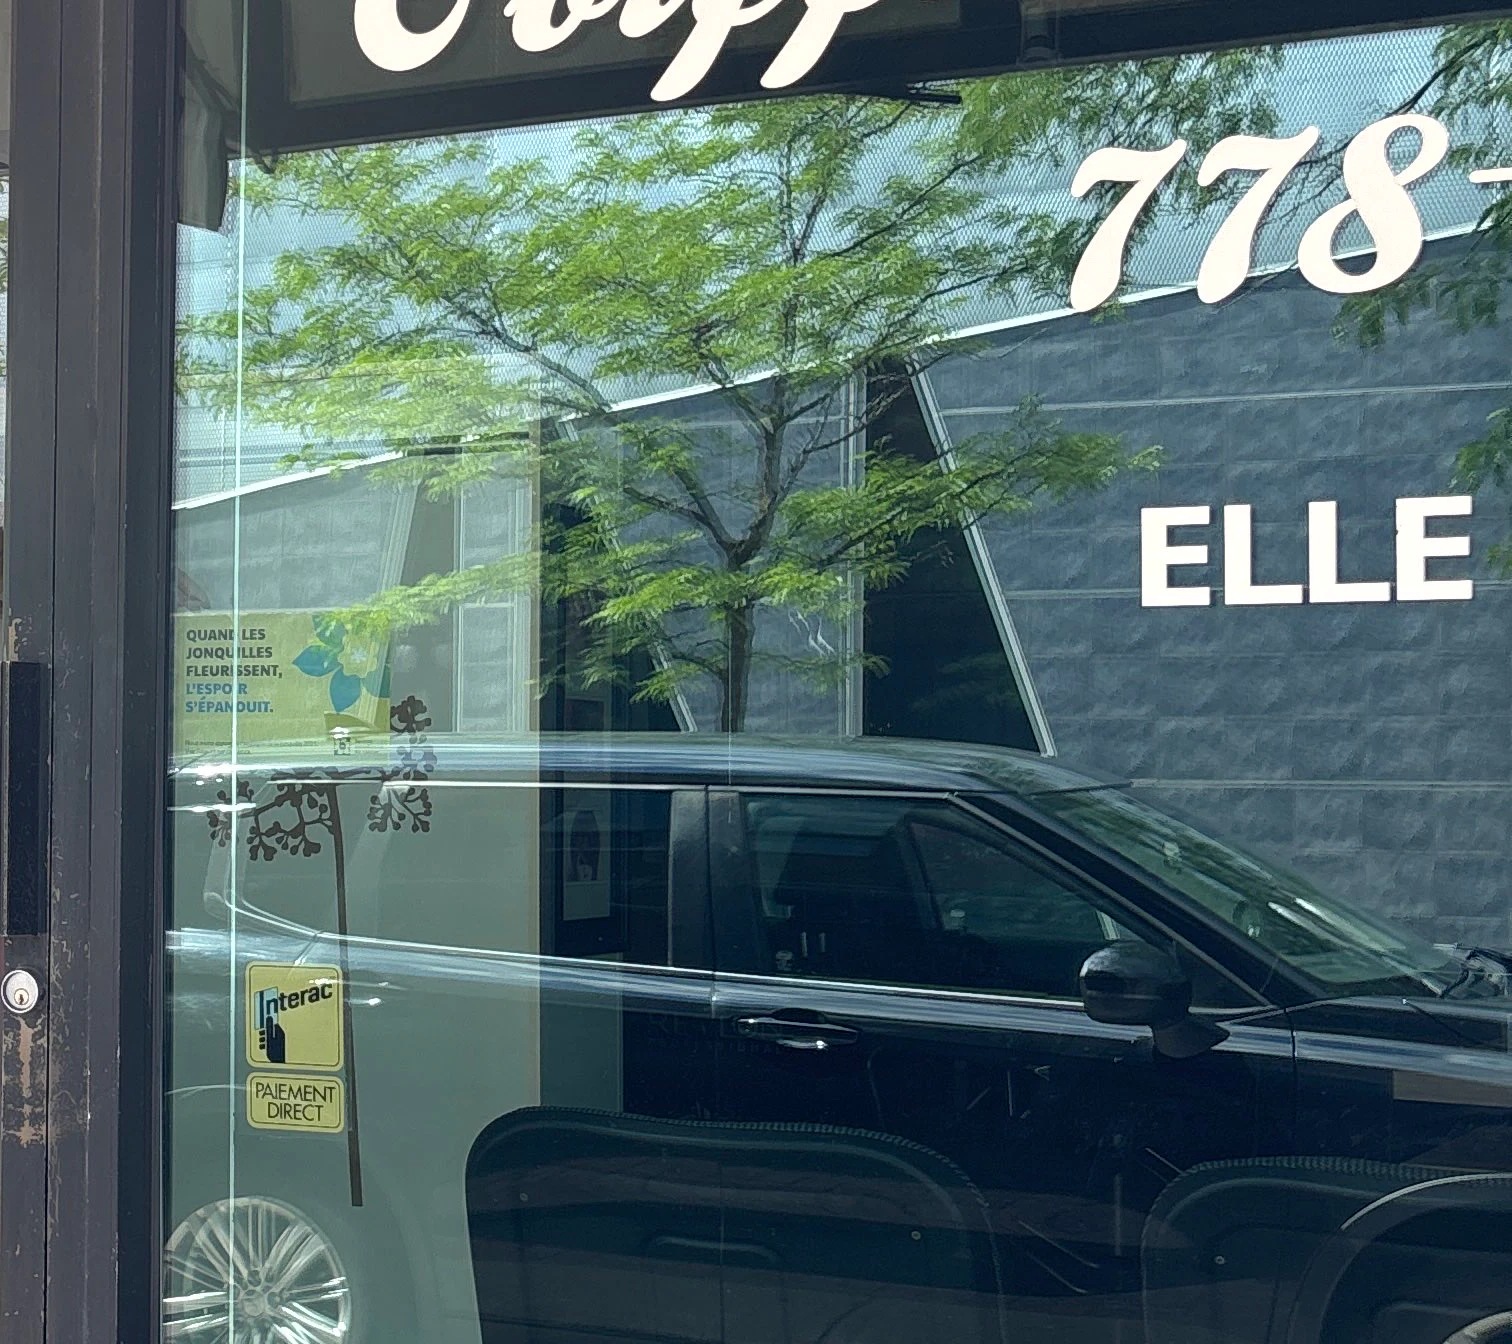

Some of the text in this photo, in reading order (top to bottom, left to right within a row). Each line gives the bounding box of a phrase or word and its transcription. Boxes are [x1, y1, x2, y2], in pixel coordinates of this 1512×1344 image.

[1138, 494, 1474, 609] ELLE
[186, 628, 266, 643] QUAND LES
[185, 646, 273, 661] JONQUILLES
[186, 664, 283, 679] FLEURISSENT,
[186, 683, 248, 695] L'ESPOR
[259, 983, 333, 1029] Interac
[255, 1082, 336, 1103] PAIEMENT
[267, 1102, 324, 1122] DIRECT
